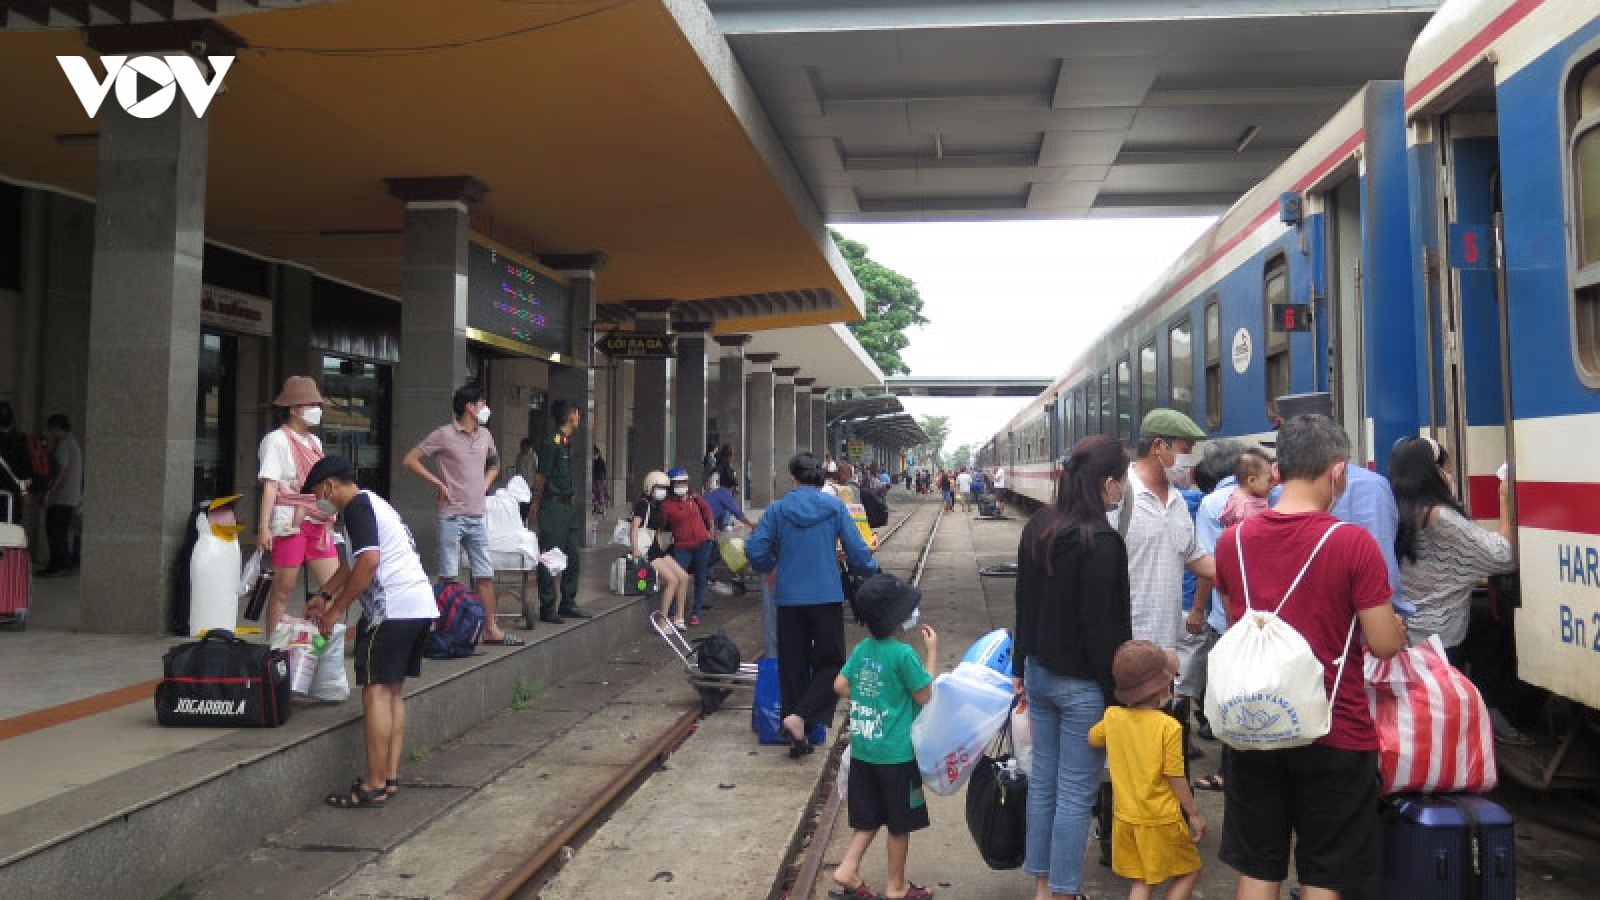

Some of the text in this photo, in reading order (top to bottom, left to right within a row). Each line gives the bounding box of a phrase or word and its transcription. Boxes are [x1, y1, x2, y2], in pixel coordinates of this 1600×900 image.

[1463, 231, 1478, 263] 5
[1283, 307, 1297, 330] 6
[1559, 604, 1587, 648] Bn
